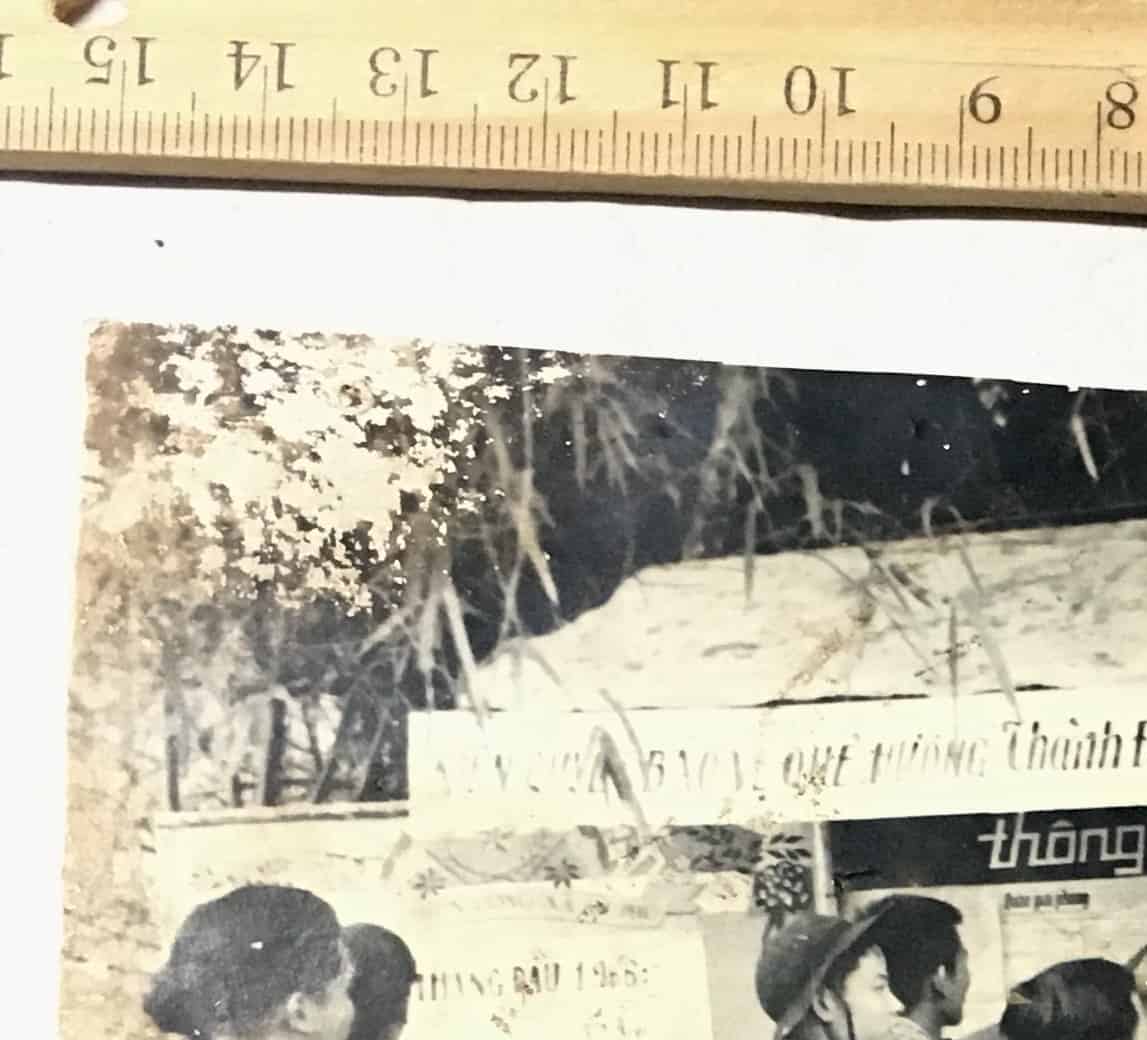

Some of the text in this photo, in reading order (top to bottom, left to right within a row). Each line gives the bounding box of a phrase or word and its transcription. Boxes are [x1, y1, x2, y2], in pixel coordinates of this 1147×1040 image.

[84, 35, 158, 86] 15
[227, 40, 296, 92] 14
[369, 47, 439, 99] 13
[507, 52, 577, 105] 12
[657, 59, 720, 111] 11
[783, 65, 857, 118] 10
[967, 76, 1002, 125] 9
[1106, 81, 1139, 130] 8
[977, 811, 1146, 876] thông
